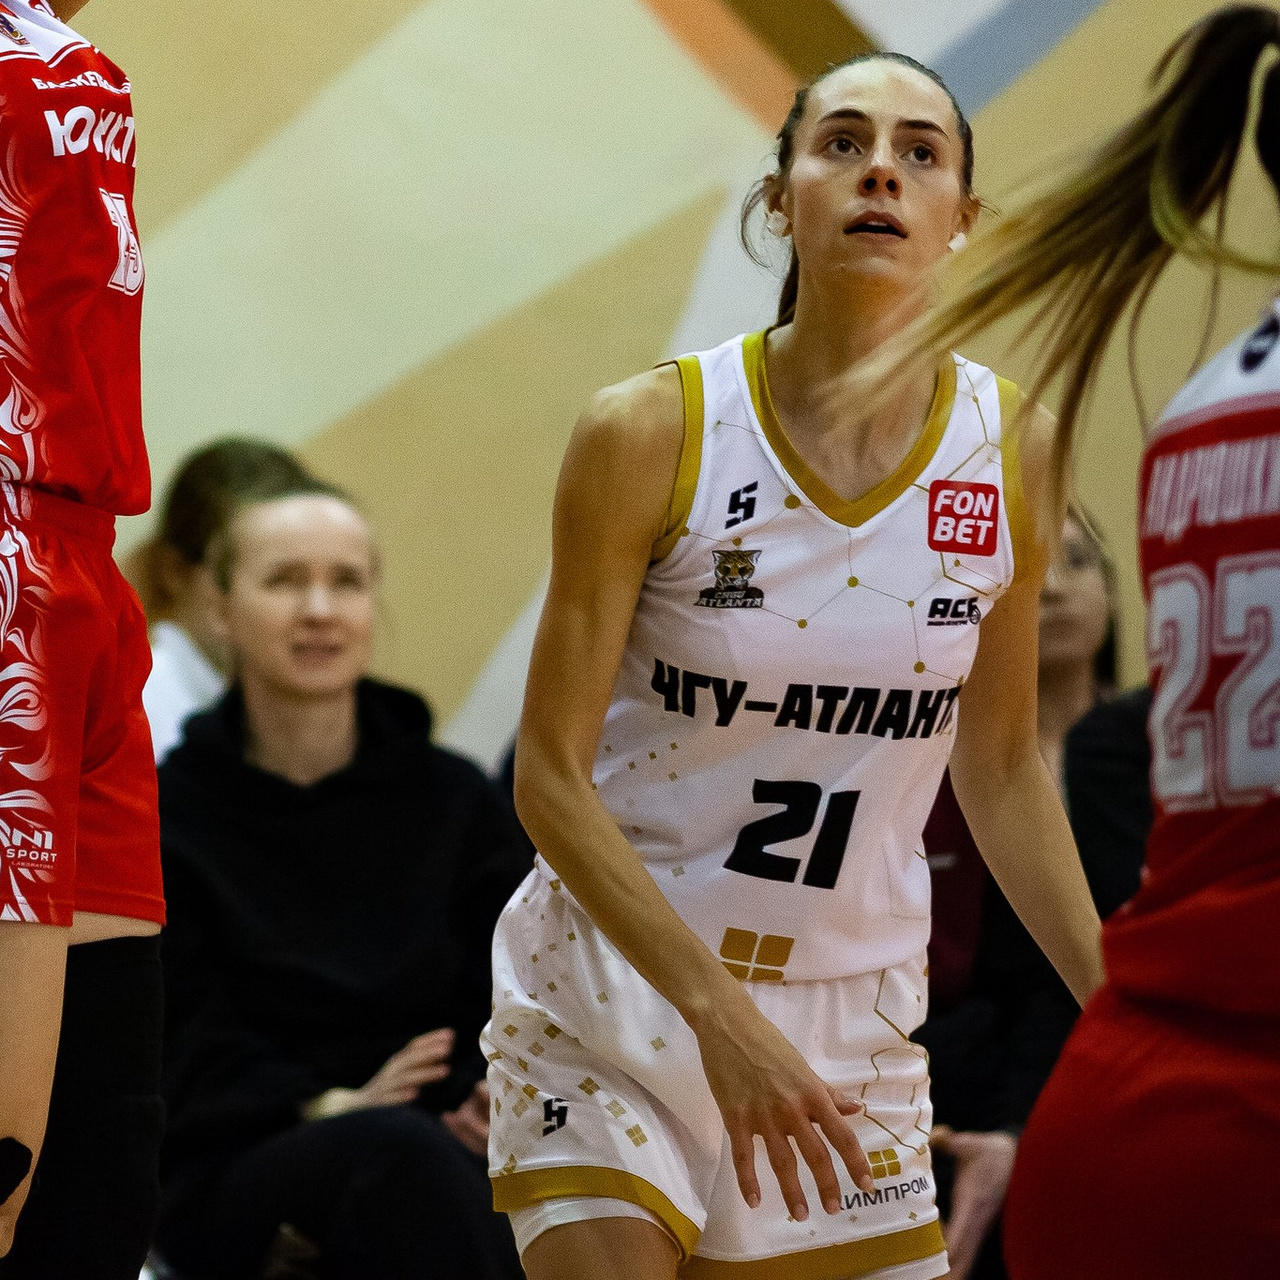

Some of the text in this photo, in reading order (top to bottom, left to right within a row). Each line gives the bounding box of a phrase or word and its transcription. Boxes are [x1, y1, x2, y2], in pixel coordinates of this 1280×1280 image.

[934, 489, 995, 519] FON
[932, 516, 994, 546] BET
[697, 597, 764, 608] ATLANTA
[1146, 548, 1280, 813] 22
[651, 657, 963, 740] ЧГУ-АТЛАНТ
[722, 778, 861, 890] 21
[6, 848, 58, 862] SPORT
[840, 1176, 930, 1210] ИМПРОМ
